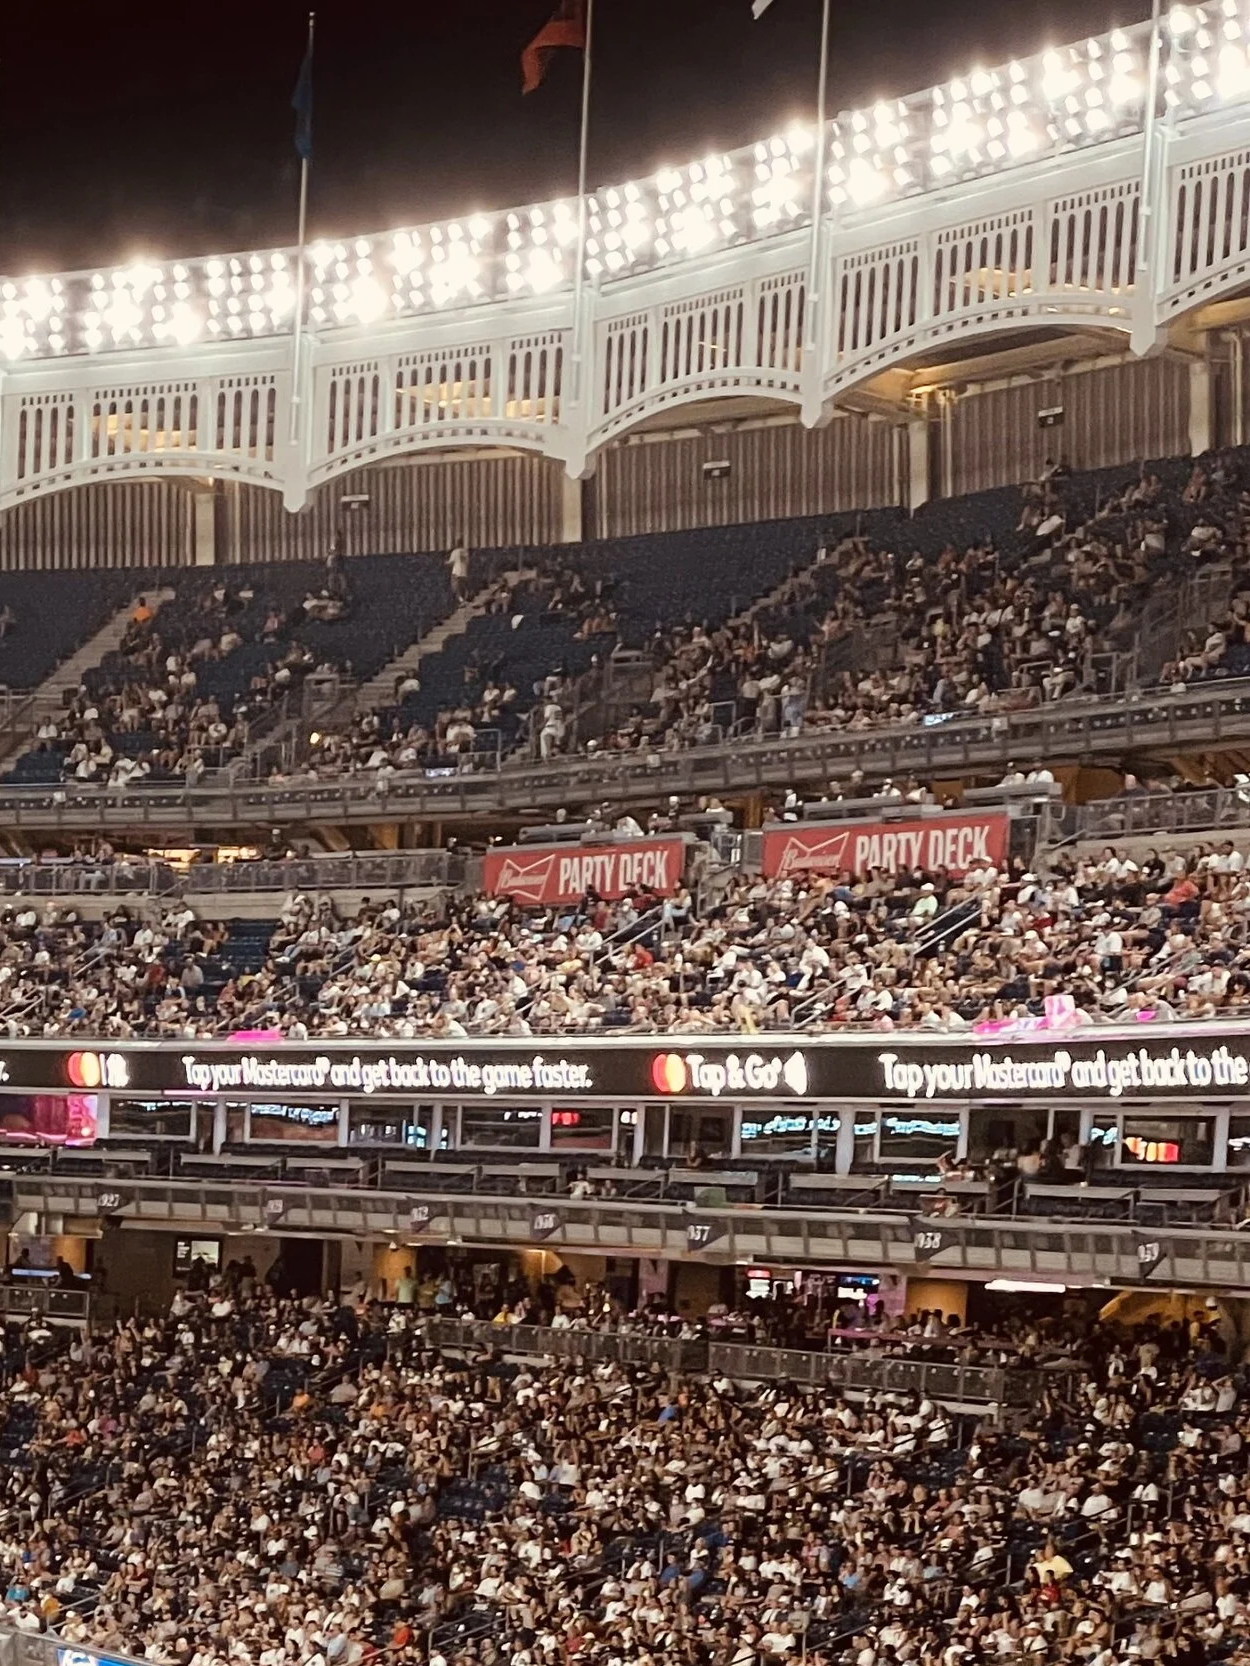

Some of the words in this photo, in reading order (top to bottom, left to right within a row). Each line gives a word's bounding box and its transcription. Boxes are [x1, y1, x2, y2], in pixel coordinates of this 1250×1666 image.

[559, 854, 616, 895] PARTY
[618, 849, 669, 891] DECK
[855, 830, 925, 876] PARTY
[929, 826, 990, 871] DECK
[182, 1056, 211, 1091] Tap
[210, 1064, 241, 1091] your
[330, 1056, 360, 1086] and
[361, 1059, 389, 1093] get
[389, 1056, 430, 1086] back
[429, 1059, 450, 1087] to
[450, 1056, 481, 1087] the
[482, 1064, 532, 1095] game
[532, 1055, 593, 1088] faster.
[685, 1053, 727, 1096] Tap
[726, 1054, 747, 1090] &
[878, 1053, 925, 1097] Tap
[924, 1065, 973, 1097] your
[1071, 1049, 1106, 1088] and
[1106, 1052, 1141, 1097] get
[1140, 1048, 1188, 1087] back
[1187, 1049, 1212, 1087] to
[1211, 1046, 1249, 1085] the
